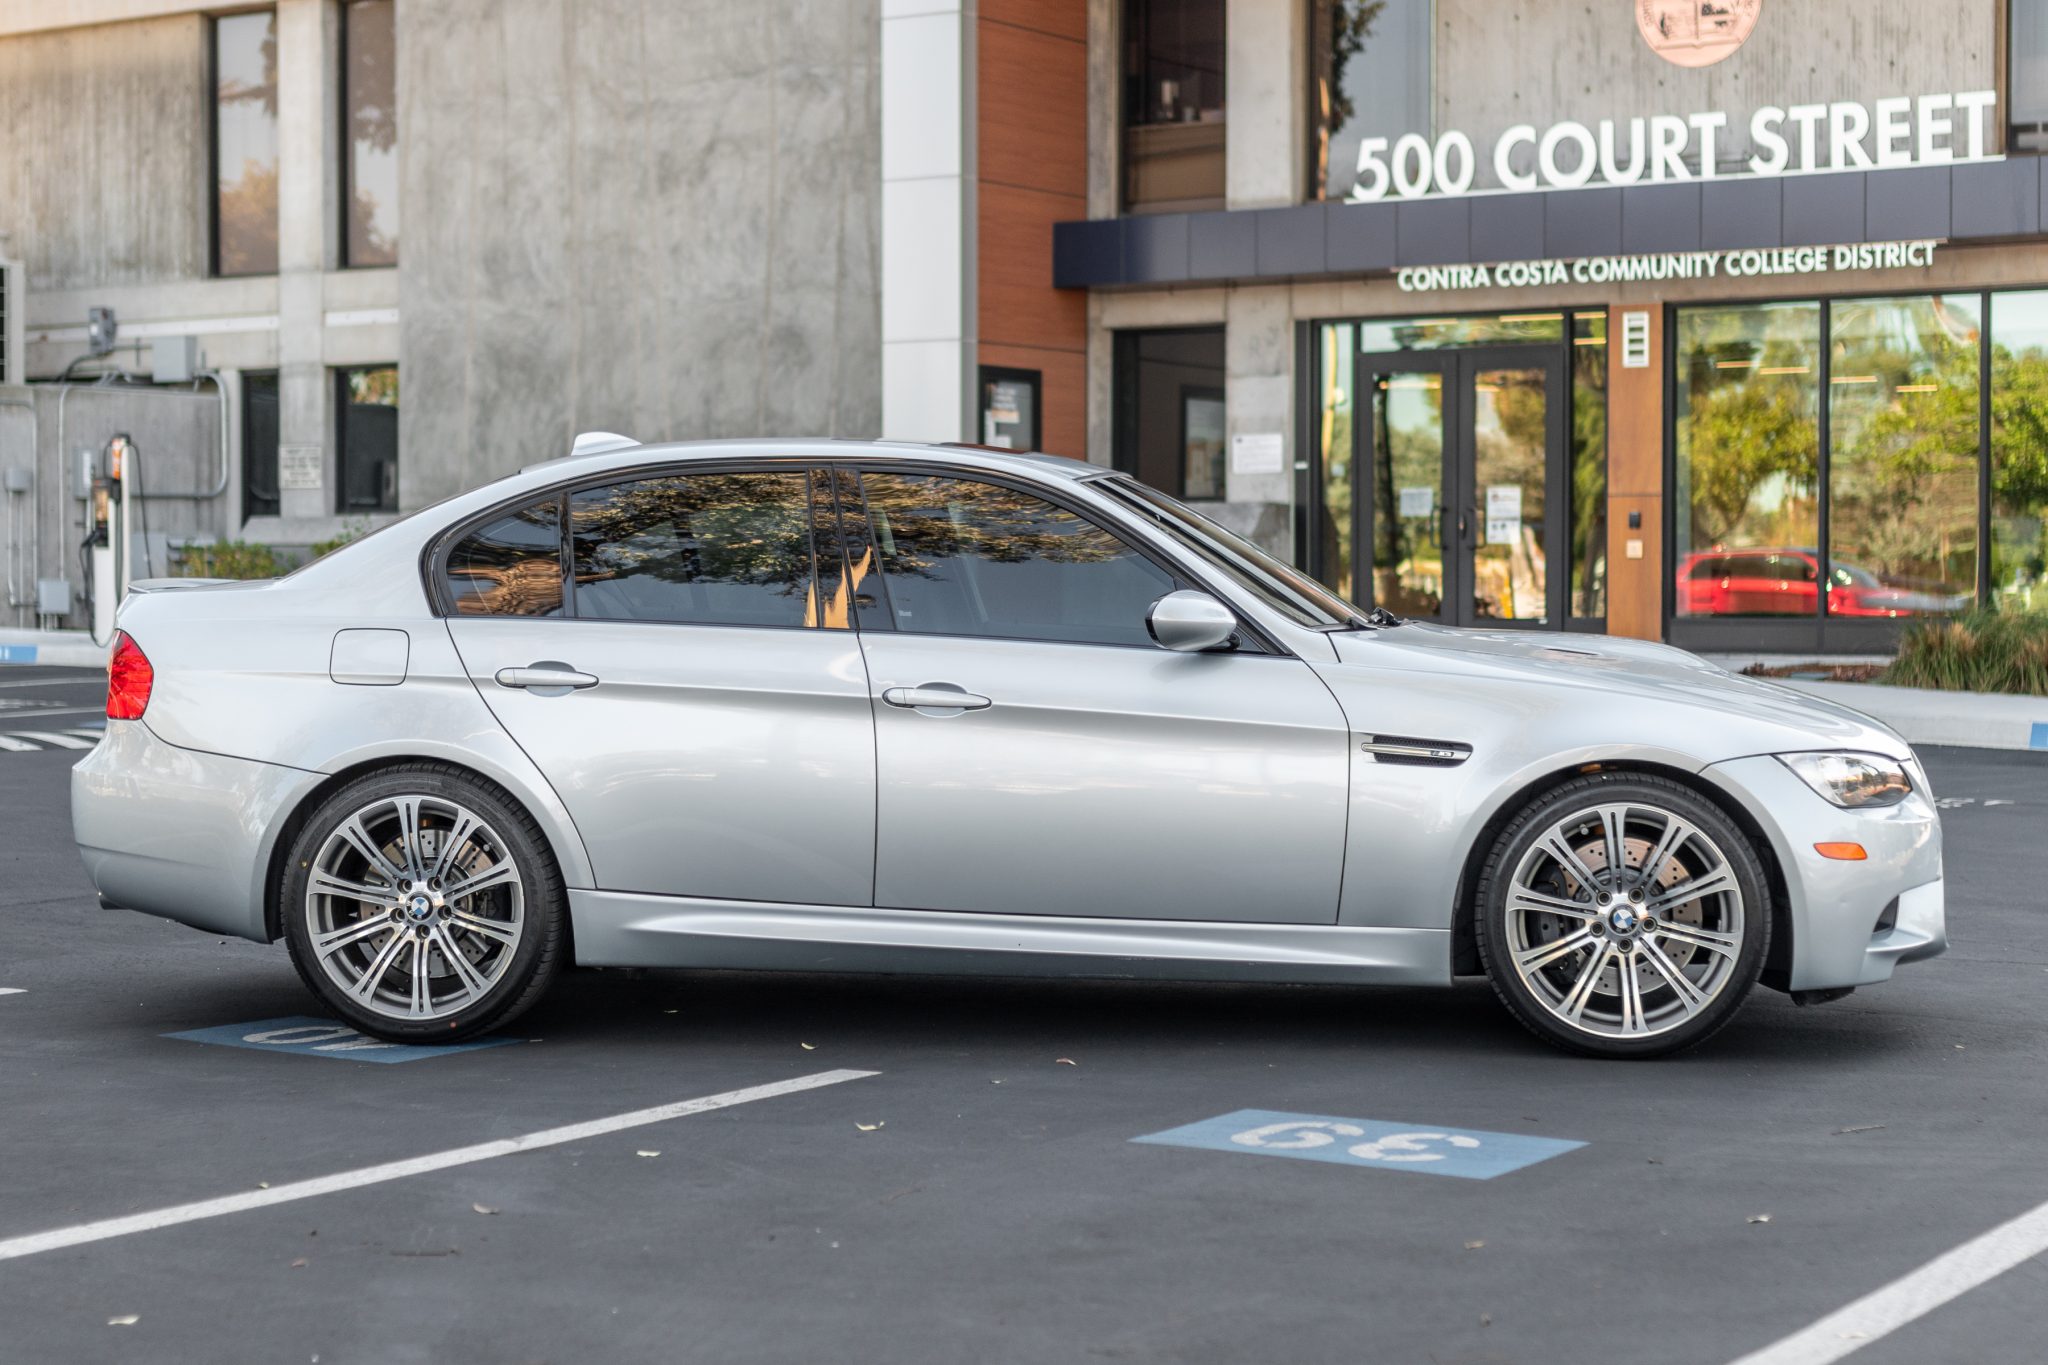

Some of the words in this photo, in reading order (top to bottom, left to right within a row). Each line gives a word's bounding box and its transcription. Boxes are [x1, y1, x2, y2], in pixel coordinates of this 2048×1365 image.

[1352, 130, 1475, 201] 500
[1494, 111, 1727, 191] COURT
[1749, 90, 1996, 176] STREET
[1397, 263, 1491, 292] CONTRA
[1495, 258, 1569, 288] COSTA
[1573, 251, 1720, 283] COMMUNITY
[1724, 246, 1827, 278] COLLEGE
[1834, 240, 1937, 271] DISTRICT
